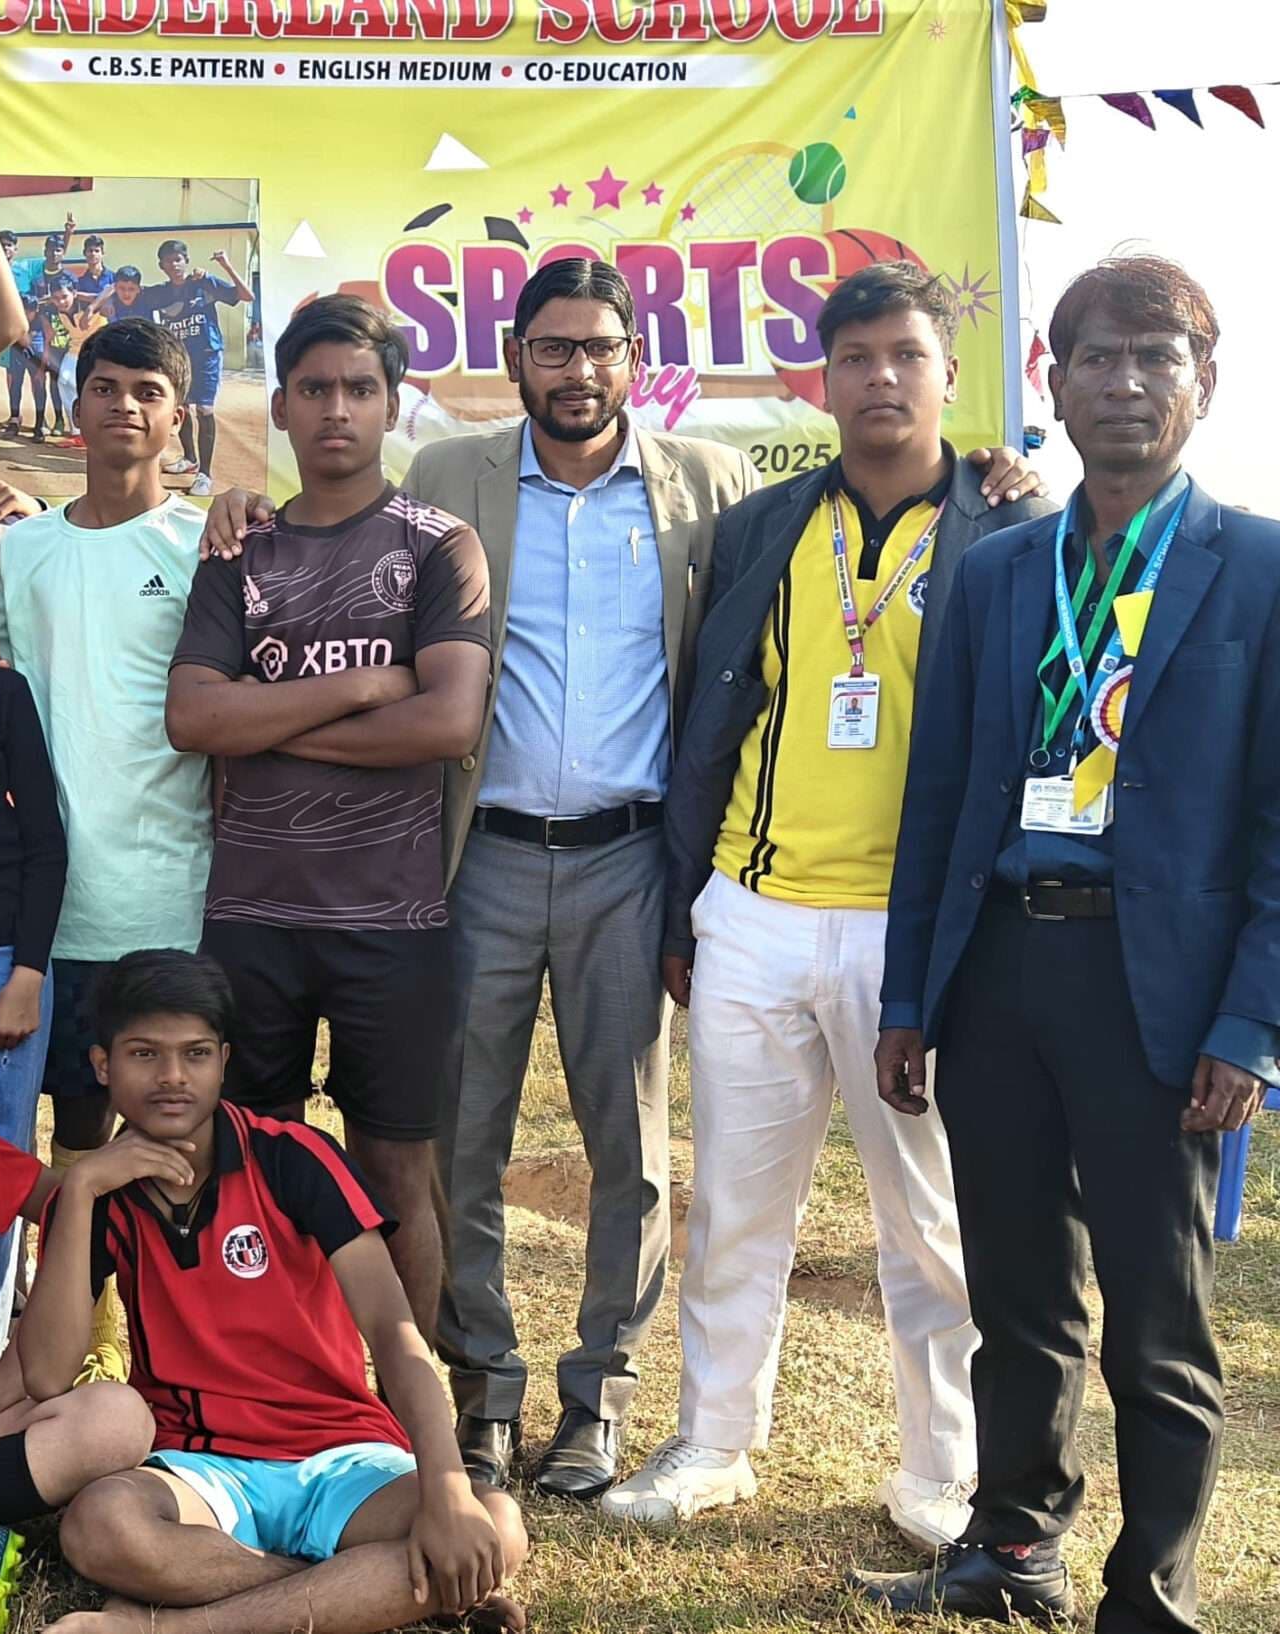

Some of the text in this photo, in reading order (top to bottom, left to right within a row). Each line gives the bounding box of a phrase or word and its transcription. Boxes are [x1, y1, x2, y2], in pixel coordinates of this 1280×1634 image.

[88, 56, 265, 79] C.B.S.E PATTERN
[298, 60, 492, 82] ENGLISH MEDIUM
[524, 62, 688, 82] CO-EDUCATION
[383, 235, 830, 373] SPRTS
[749, 443, 832, 473] 2025
[138, 586, 170, 597] adidas
[297, 637, 393, 677] XBTO
